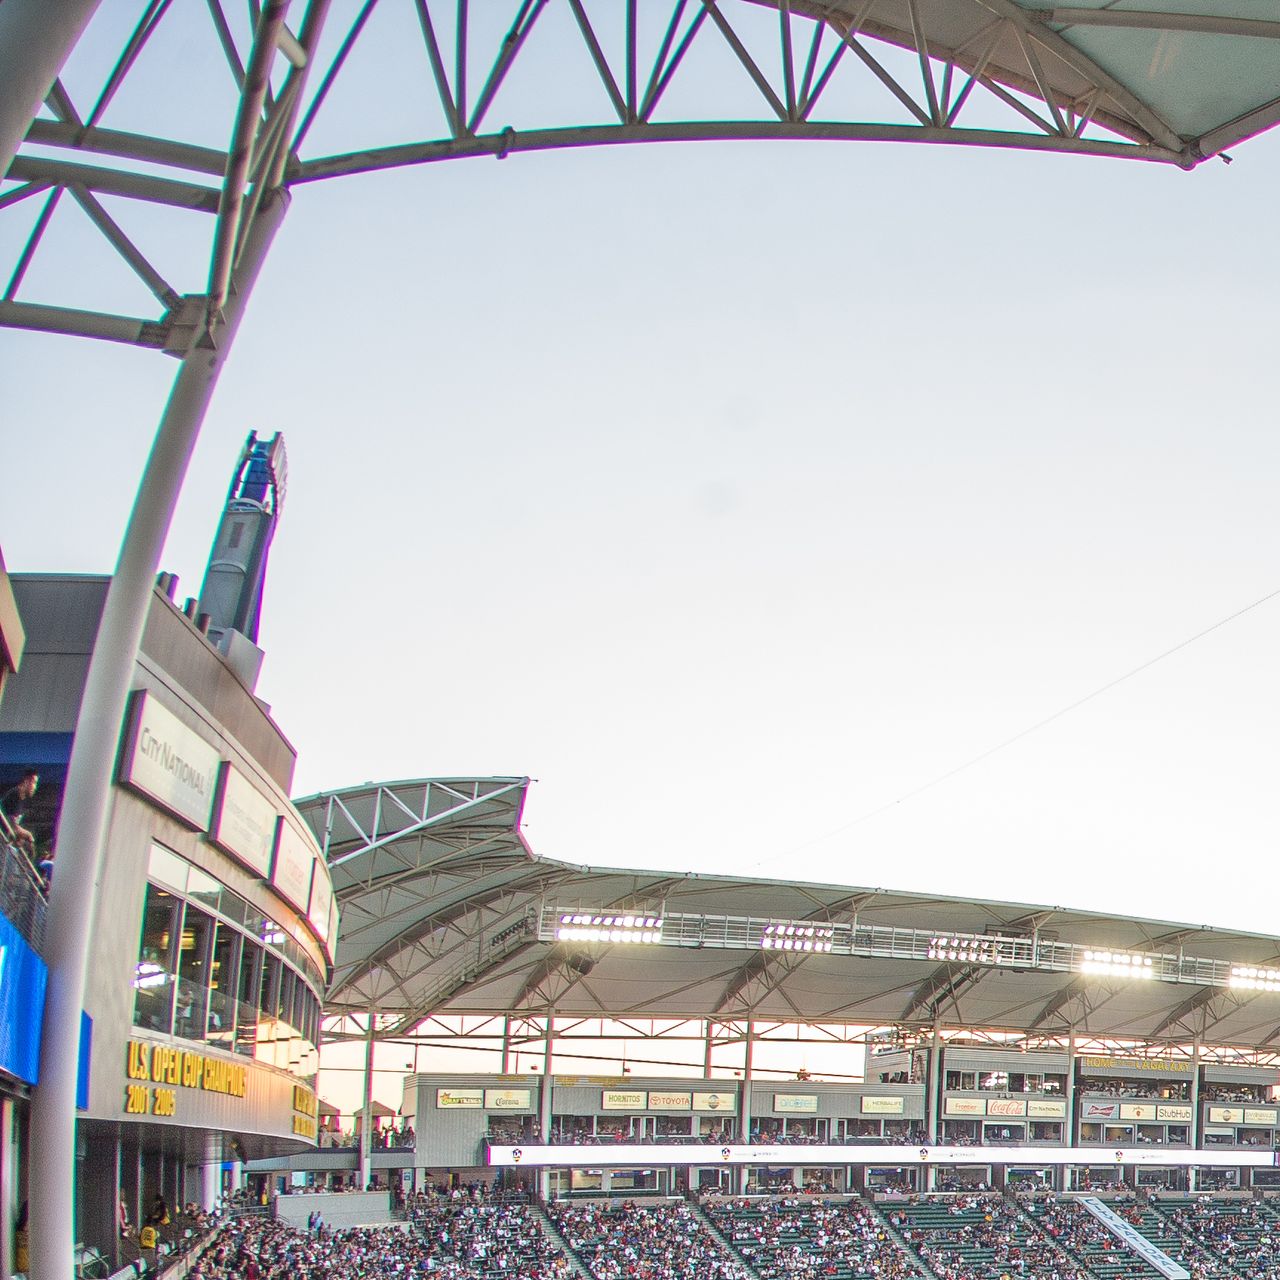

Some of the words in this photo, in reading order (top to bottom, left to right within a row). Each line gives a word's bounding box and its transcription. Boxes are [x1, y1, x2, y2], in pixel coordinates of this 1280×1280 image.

[160, 741, 206, 796] NATIONAL
[128, 1040, 150, 1079] U.S.
[152, 1045, 181, 1086] OPEN
[182, 1051, 204, 1089] CUP
[203, 1056, 247, 1098] CHAMPIONS
[126, 1085, 150, 1114] 2001
[608, 1095, 640, 1103] HORNITOS
[661, 1097, 690, 1105] TOYOTA
[955, 1103, 977, 1111] Frontier
[1159, 1108, 1190, 1118] StubHub
